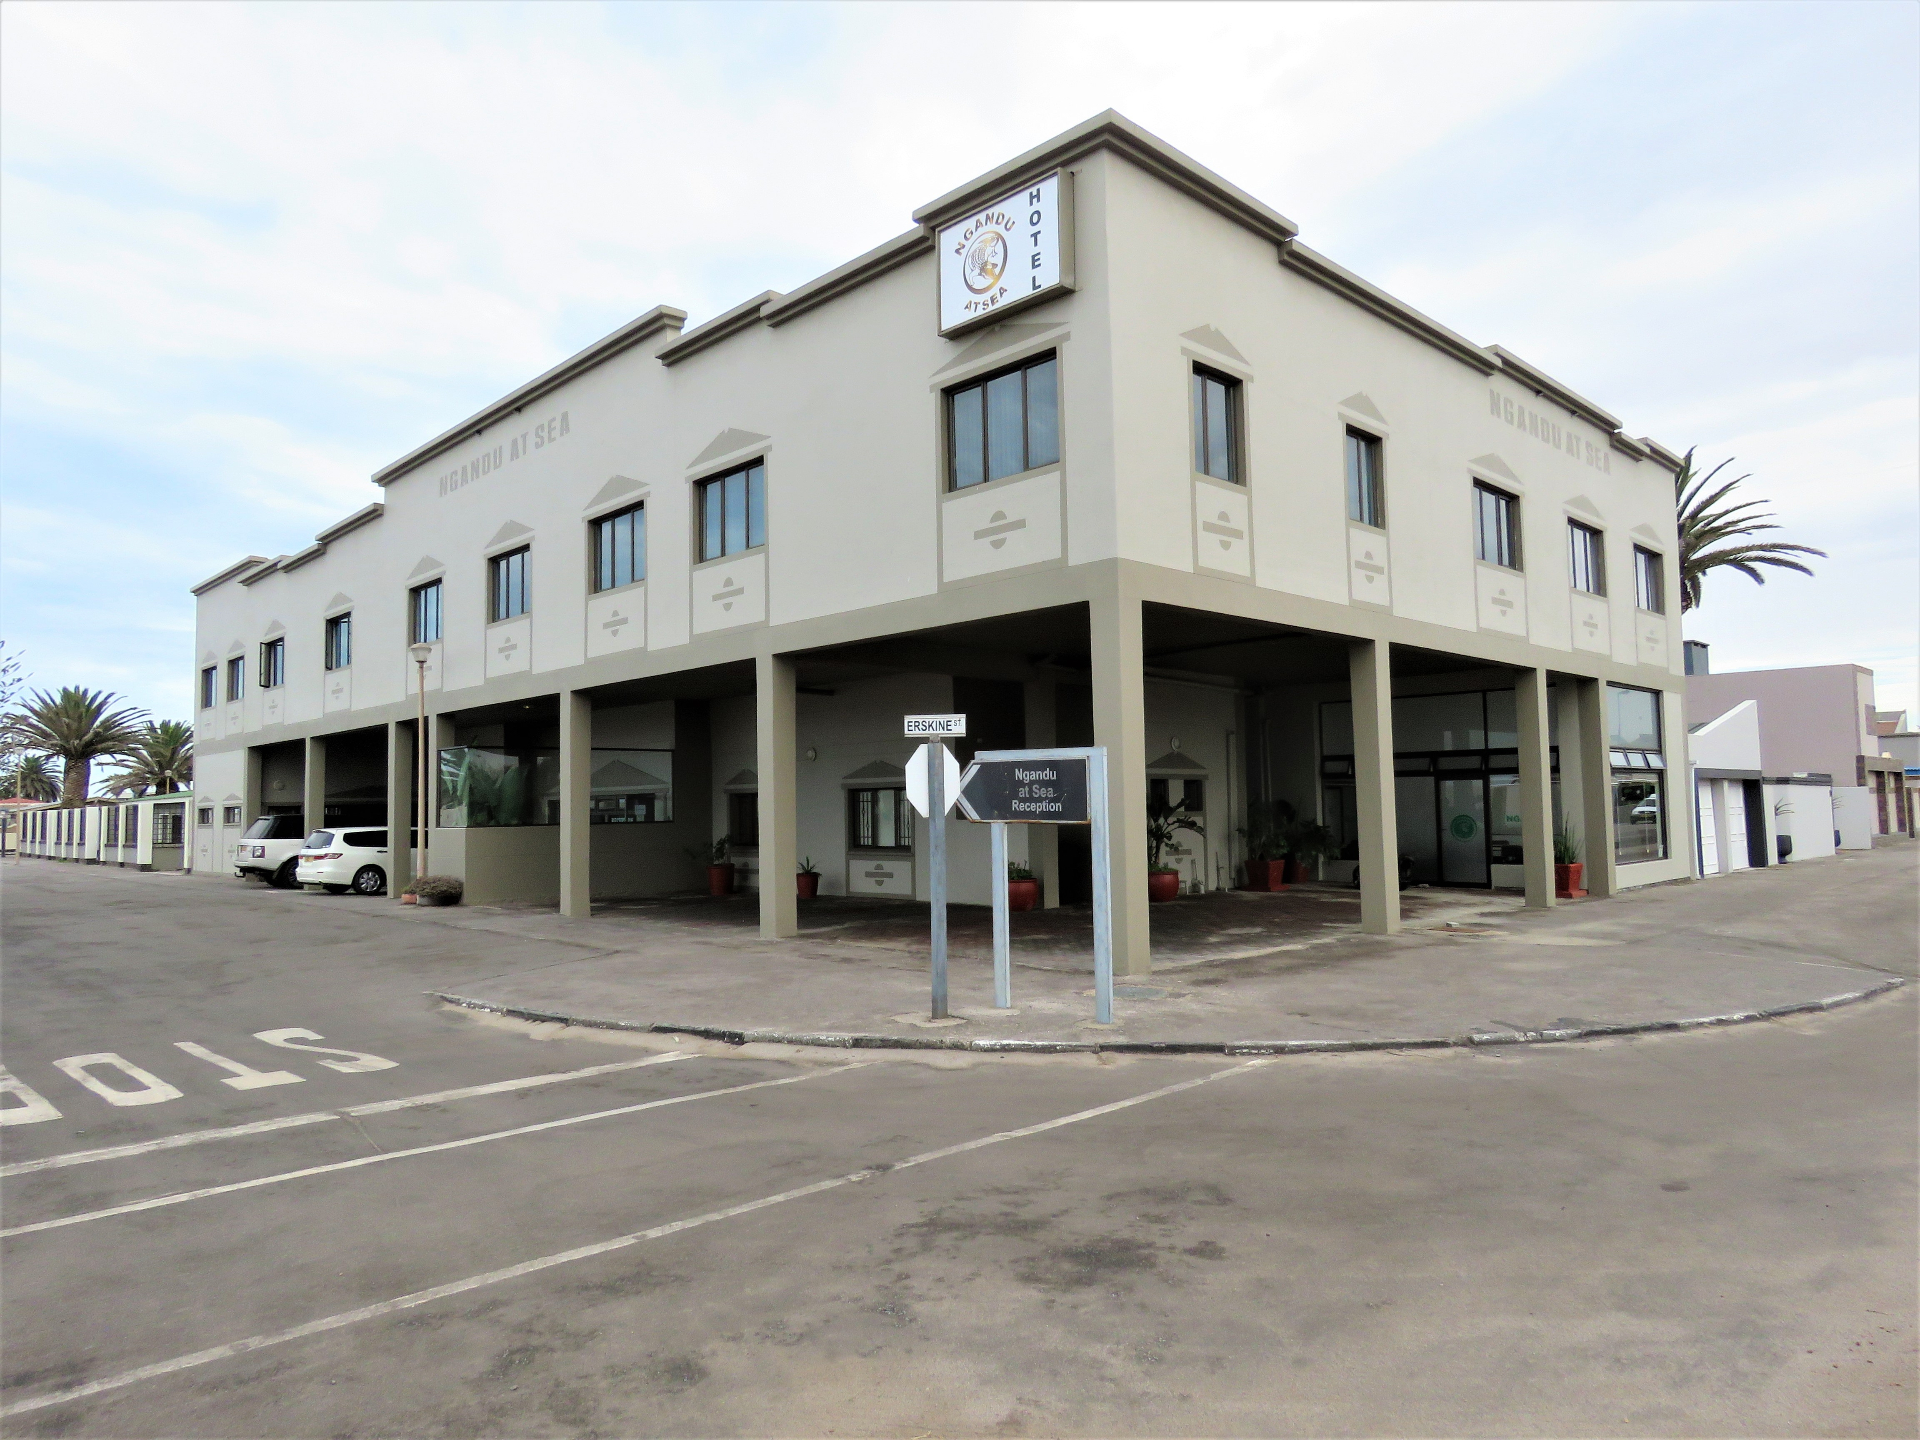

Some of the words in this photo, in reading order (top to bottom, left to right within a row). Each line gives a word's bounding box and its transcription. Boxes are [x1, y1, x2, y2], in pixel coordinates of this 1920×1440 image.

[954, 211, 1016, 256] NGANDU
[1028, 187, 1042, 292] HOTEL
[1489, 388, 1562, 451] NGANDU
[1565, 431, 1582, 461] AT
[1584, 440, 1611, 476] SEA
[439, 445, 503, 498] NGANDU
[509, 431, 529, 462] AT
[534, 410, 571, 450] SEA
[906, 718, 953, 732] ERSKINE
[1014, 767, 1057, 784] Ngandu
[1018, 785, 1030, 798] at
[1032, 784, 1054, 798] Sea
[1011, 799, 1063, 814] Reception
